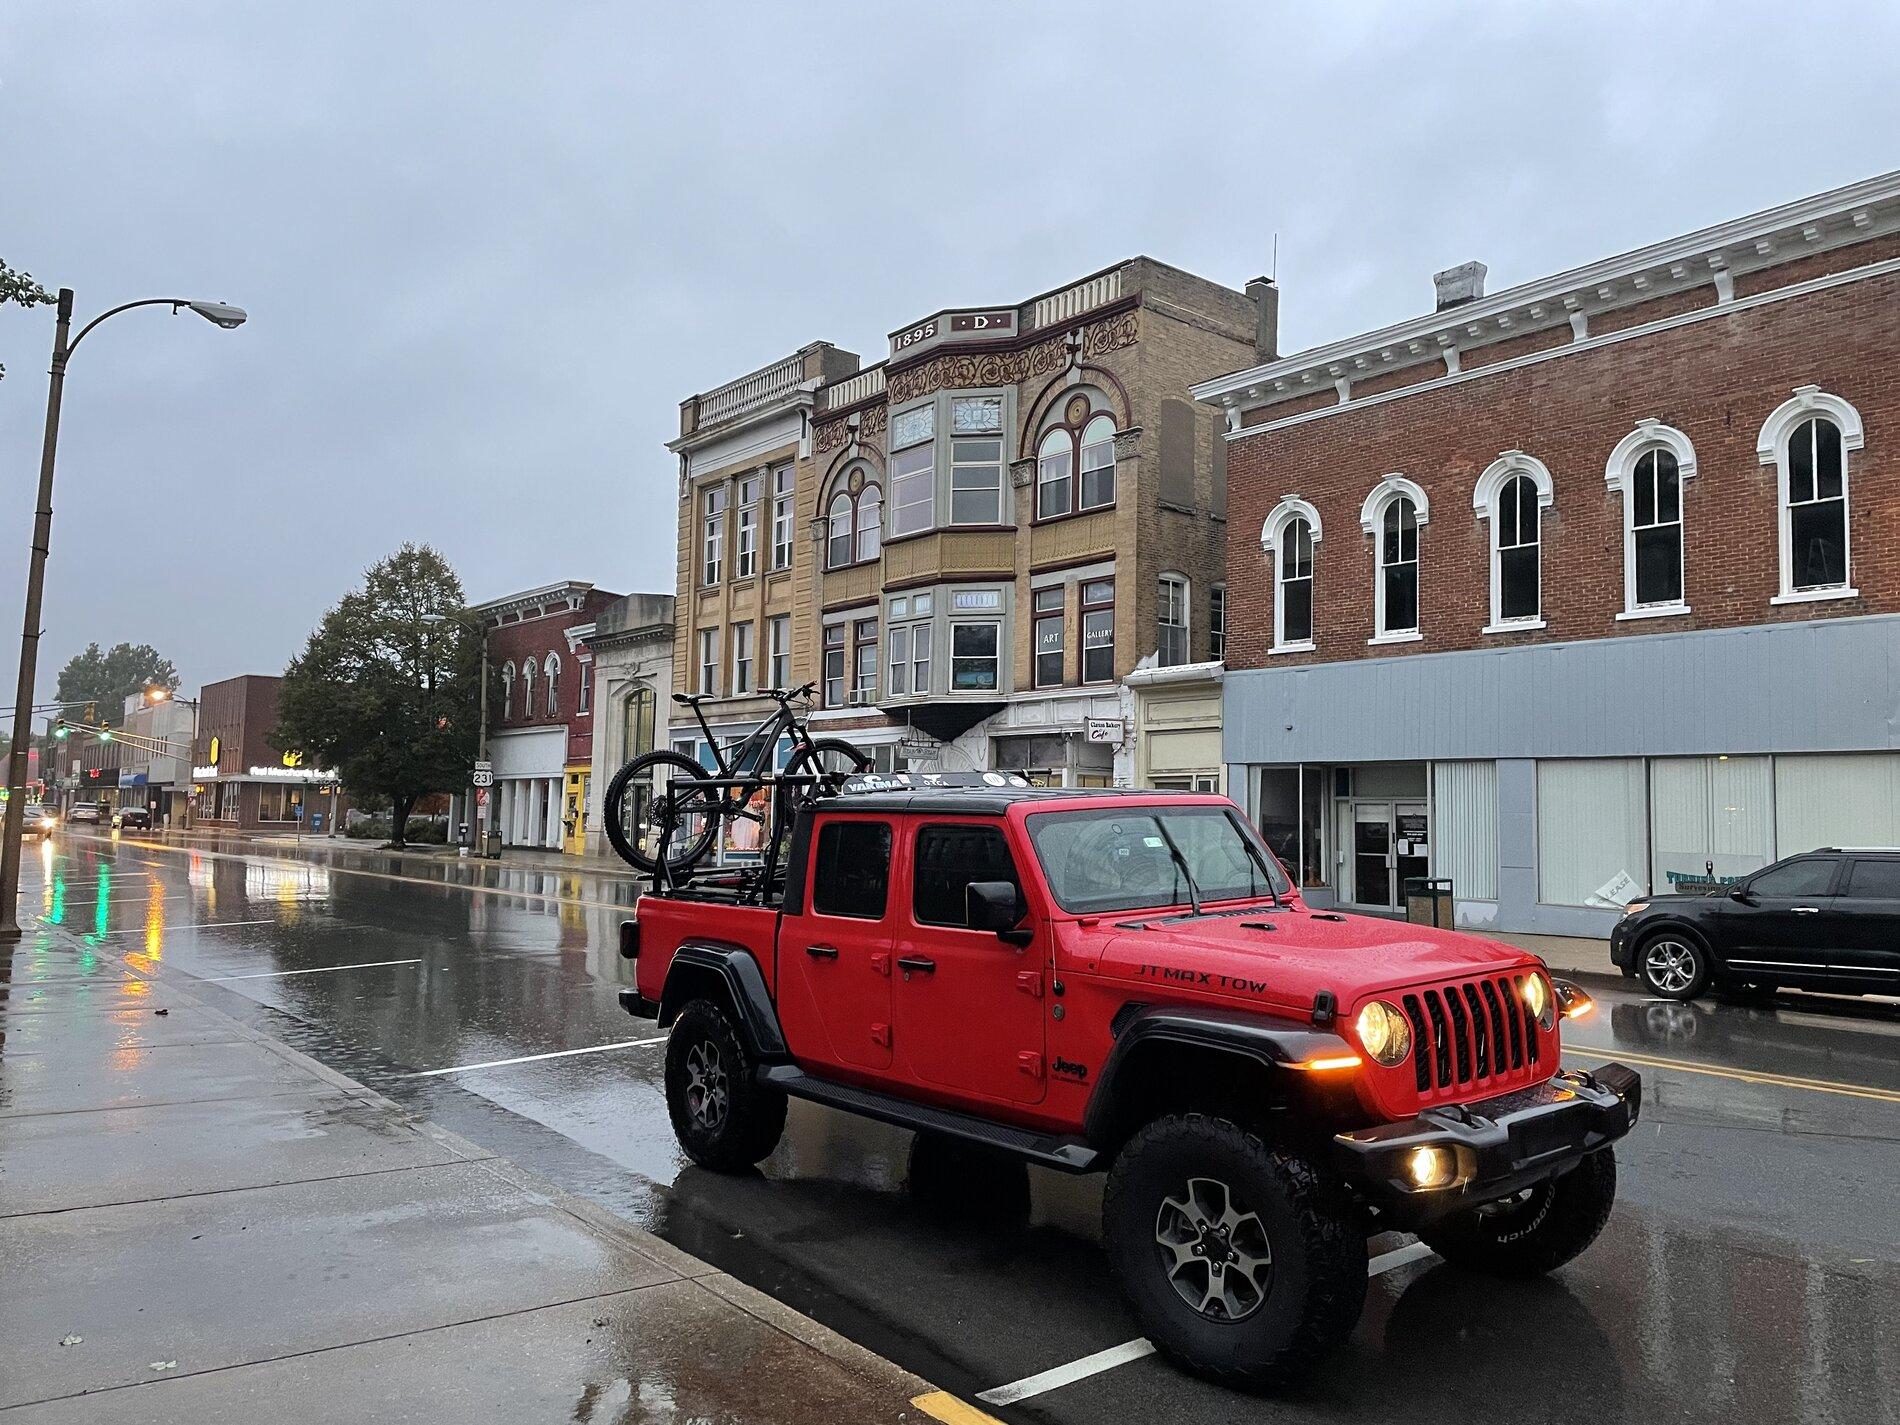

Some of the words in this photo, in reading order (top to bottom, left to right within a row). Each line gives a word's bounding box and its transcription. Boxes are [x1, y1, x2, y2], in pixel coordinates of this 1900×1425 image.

[897, 324, 935, 350] 1895
[1043, 632, 1059, 643] ART
[1087, 629, 1112, 639] GALLERY
[1092, 730, 1108, 740] Cafe
[474, 773, 492, 784] 231
[848, 780, 902, 792] YAKIMA
[1605, 876, 1631, 899] LEASE
[1163, 967, 1210, 985] MAX
[1219, 975, 1267, 994] TOW
[1052, 1055, 1088, 1080] Jeep
